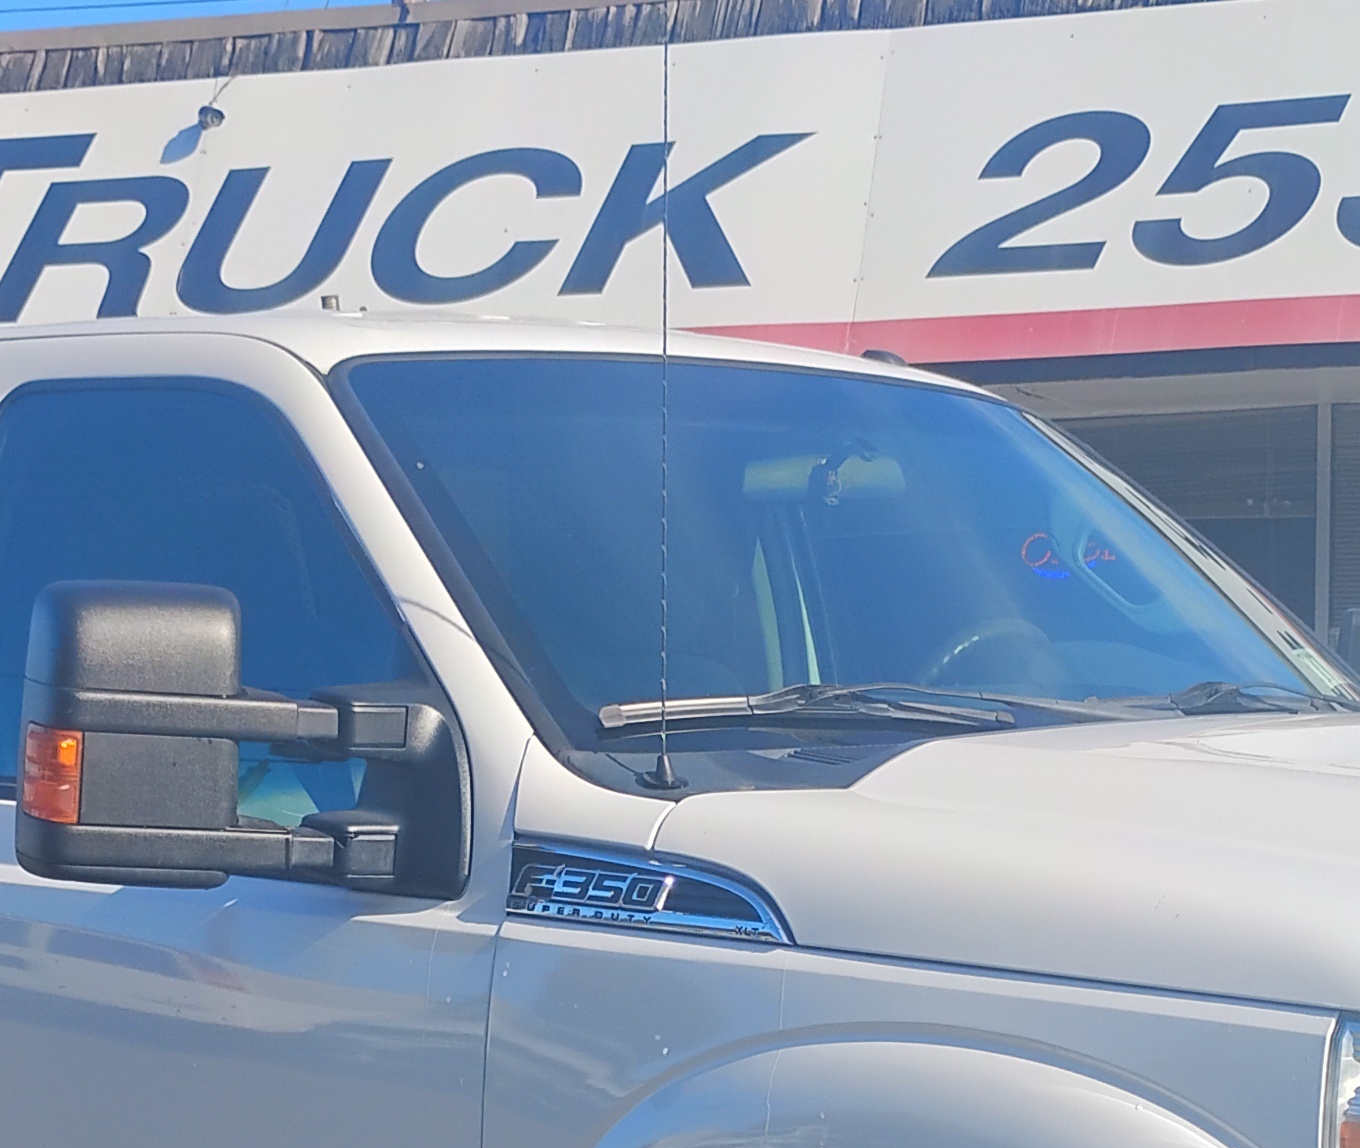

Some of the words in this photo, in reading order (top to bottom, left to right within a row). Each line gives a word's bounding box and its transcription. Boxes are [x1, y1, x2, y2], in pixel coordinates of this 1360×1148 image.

[510, 901, 581, 916] SUPER
[593, 910, 652, 924] DUTY
[735, 925, 760, 936] XLT
